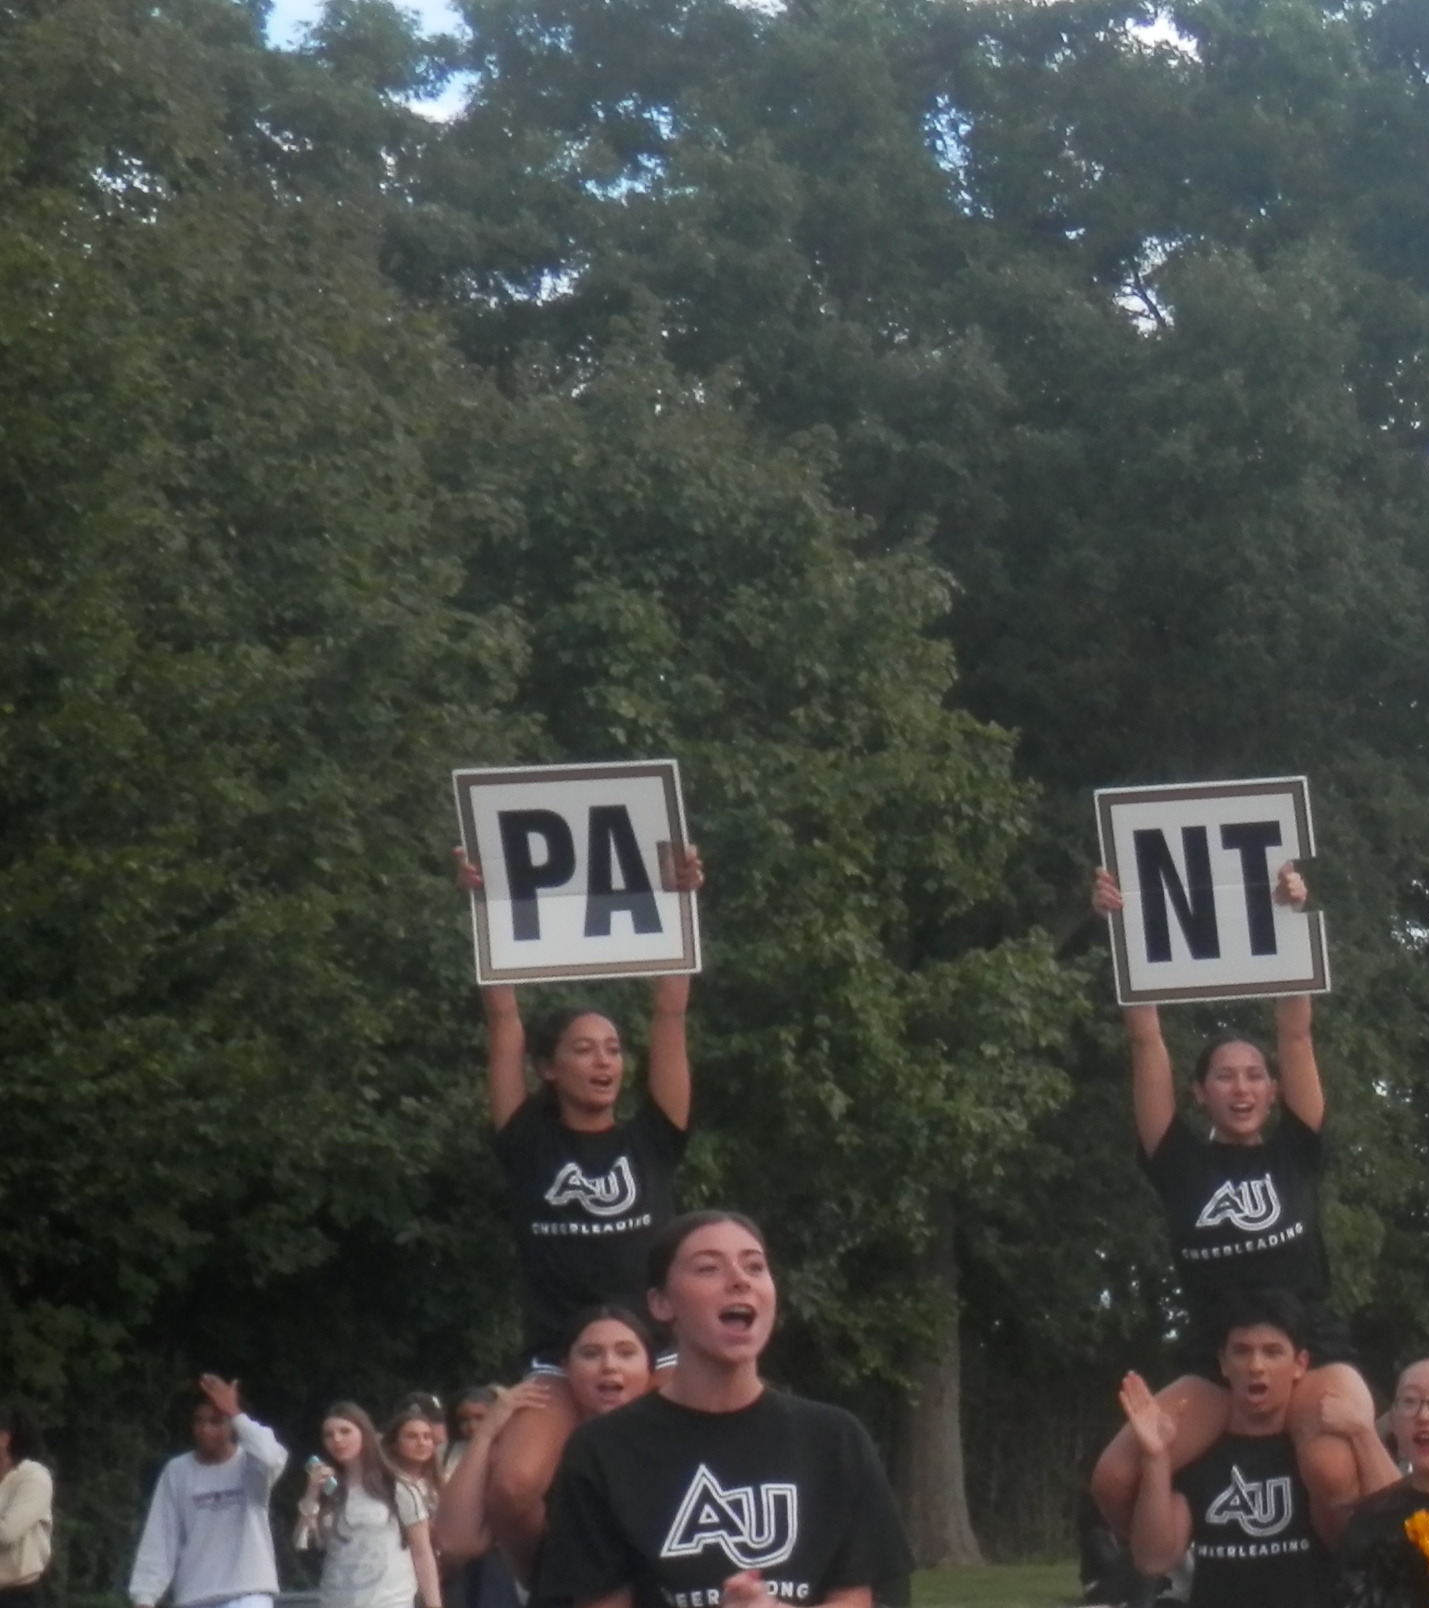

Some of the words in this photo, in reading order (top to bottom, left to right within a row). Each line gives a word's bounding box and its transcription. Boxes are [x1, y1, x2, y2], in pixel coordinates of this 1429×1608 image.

[497, 804, 664, 941] PA
[1133, 820, 1282, 963] NT
[544, 1156, 636, 1216] AU
[1195, 1172, 1281, 1231] AU
[659, 1463, 798, 1569] AU
[1205, 1464, 1292, 1537] AU
